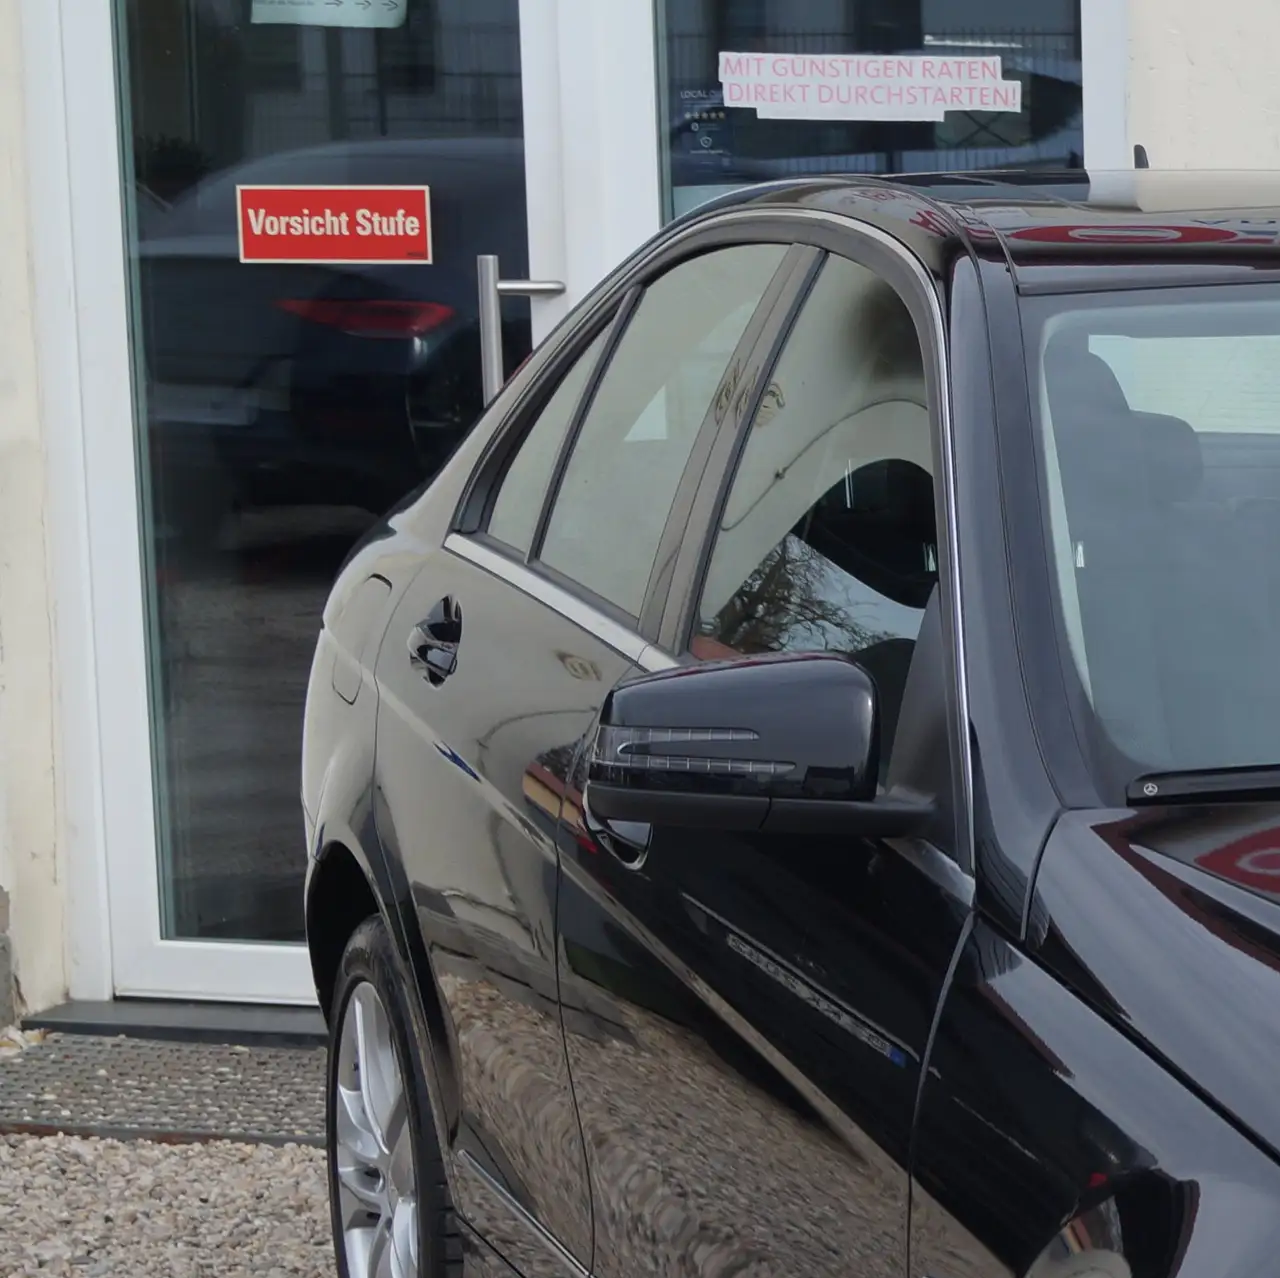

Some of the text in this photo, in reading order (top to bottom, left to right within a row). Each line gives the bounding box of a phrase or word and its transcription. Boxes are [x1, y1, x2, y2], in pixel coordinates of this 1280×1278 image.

[723, 57, 766, 77] MIT
[920, 60, 998, 81] RATEN
[727, 83, 1018, 107] DIREKT DURCHSTARTEN!
[247, 208, 421, 237] Vorsicht Stufe
